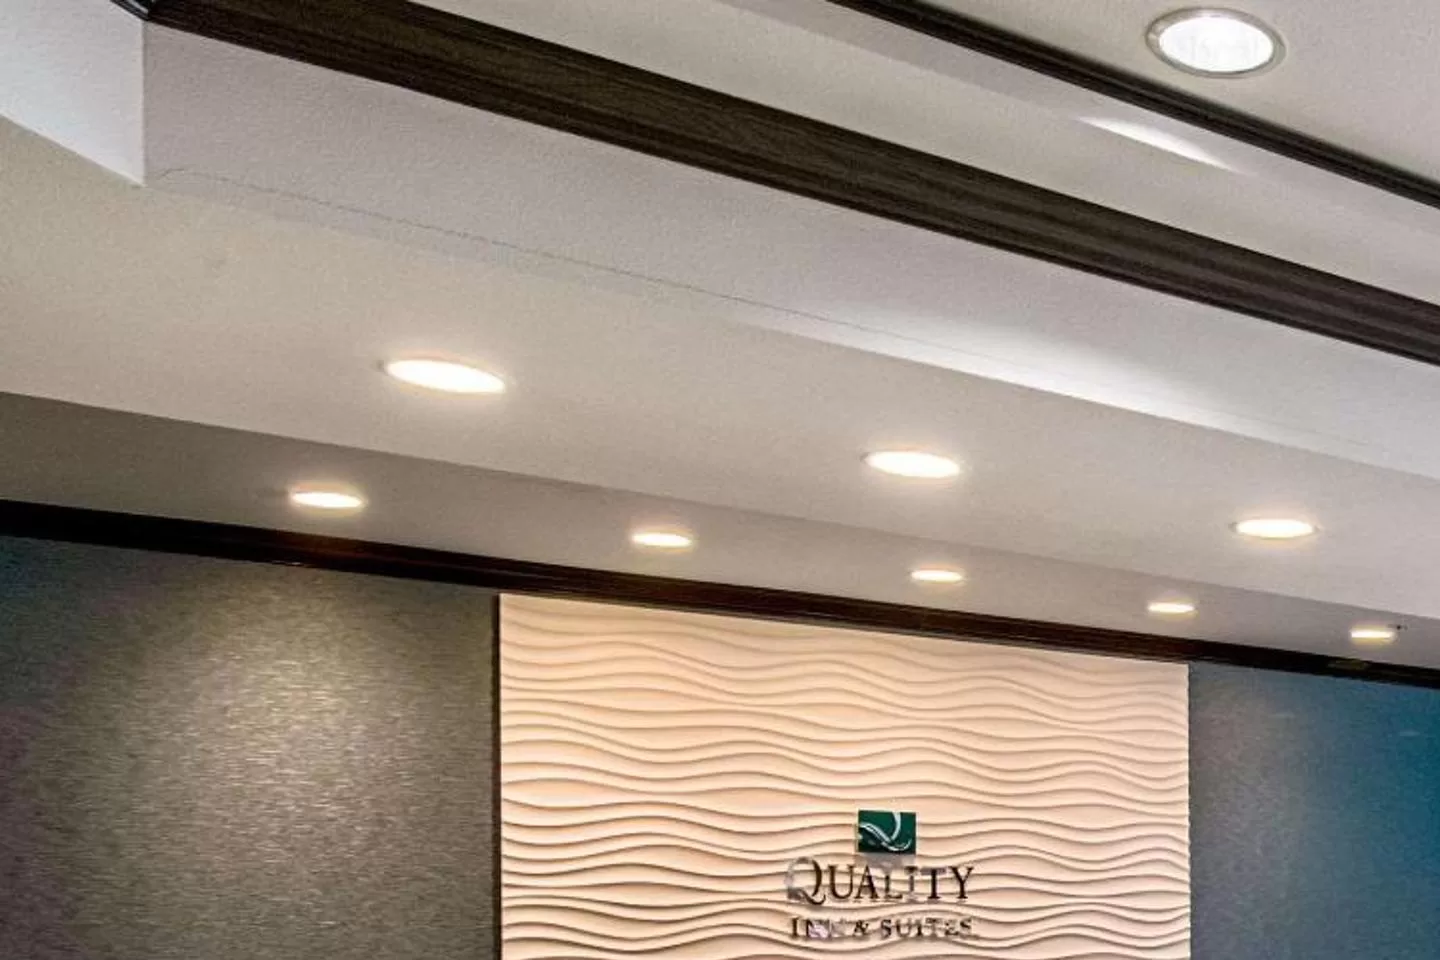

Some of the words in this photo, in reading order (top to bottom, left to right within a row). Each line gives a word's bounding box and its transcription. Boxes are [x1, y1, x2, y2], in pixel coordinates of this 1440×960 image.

[785, 857, 974, 905] QUALITY
[852, 918, 869, 937] &
[880, 917, 972, 938] SUITES
